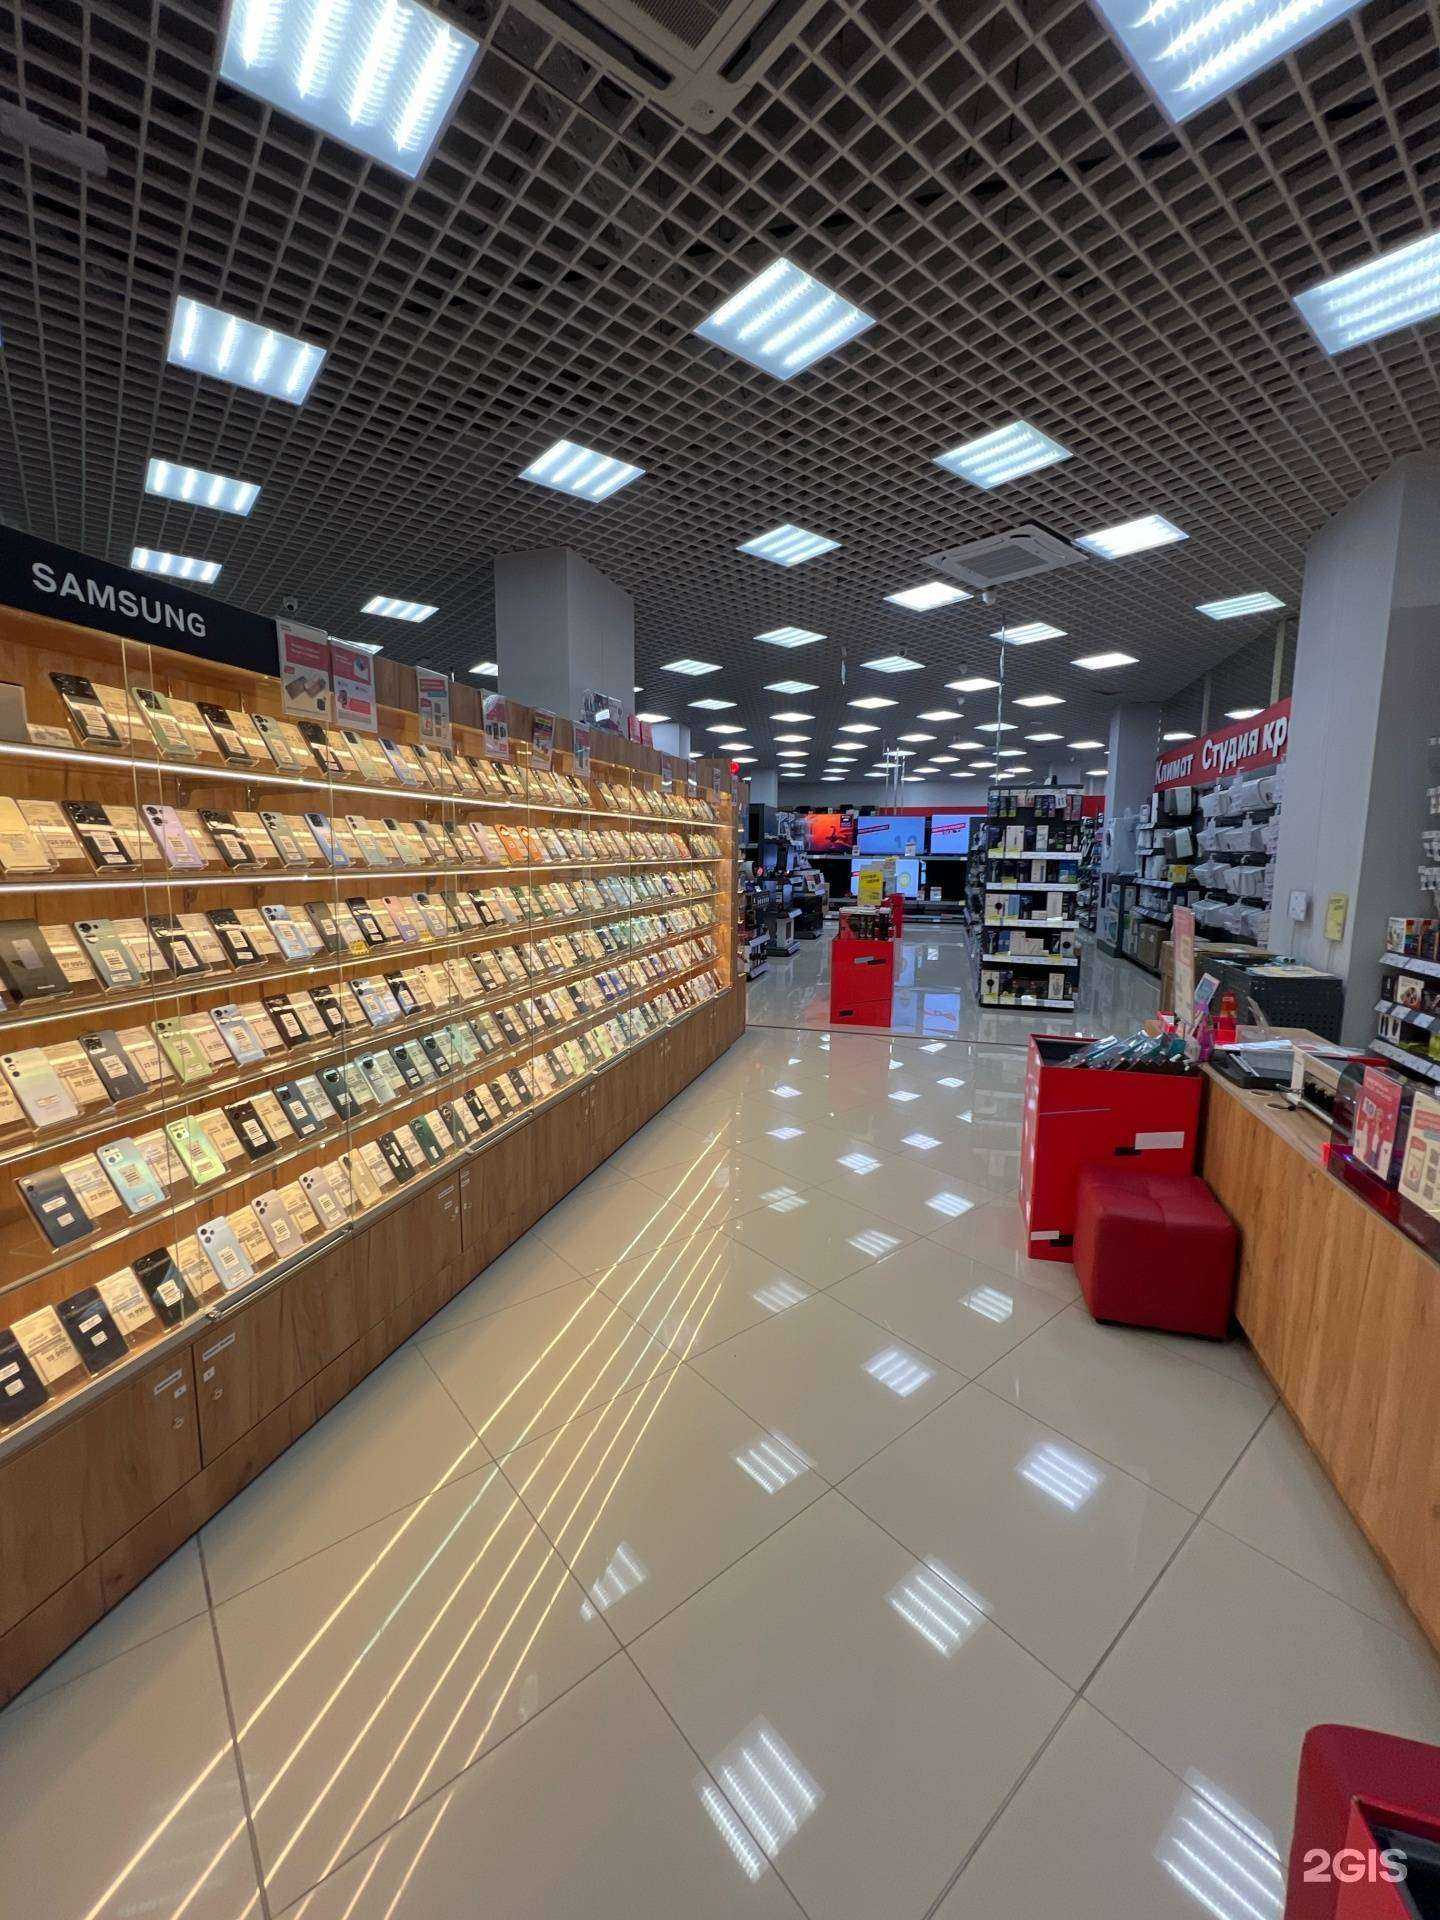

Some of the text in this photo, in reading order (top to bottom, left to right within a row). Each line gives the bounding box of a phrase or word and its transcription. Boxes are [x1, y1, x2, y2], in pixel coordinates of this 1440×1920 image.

[32, 562, 206, 637] SAMSUNG
[1156, 754, 1194, 785] Климат
[1202, 716, 1290, 773] Студия кр
